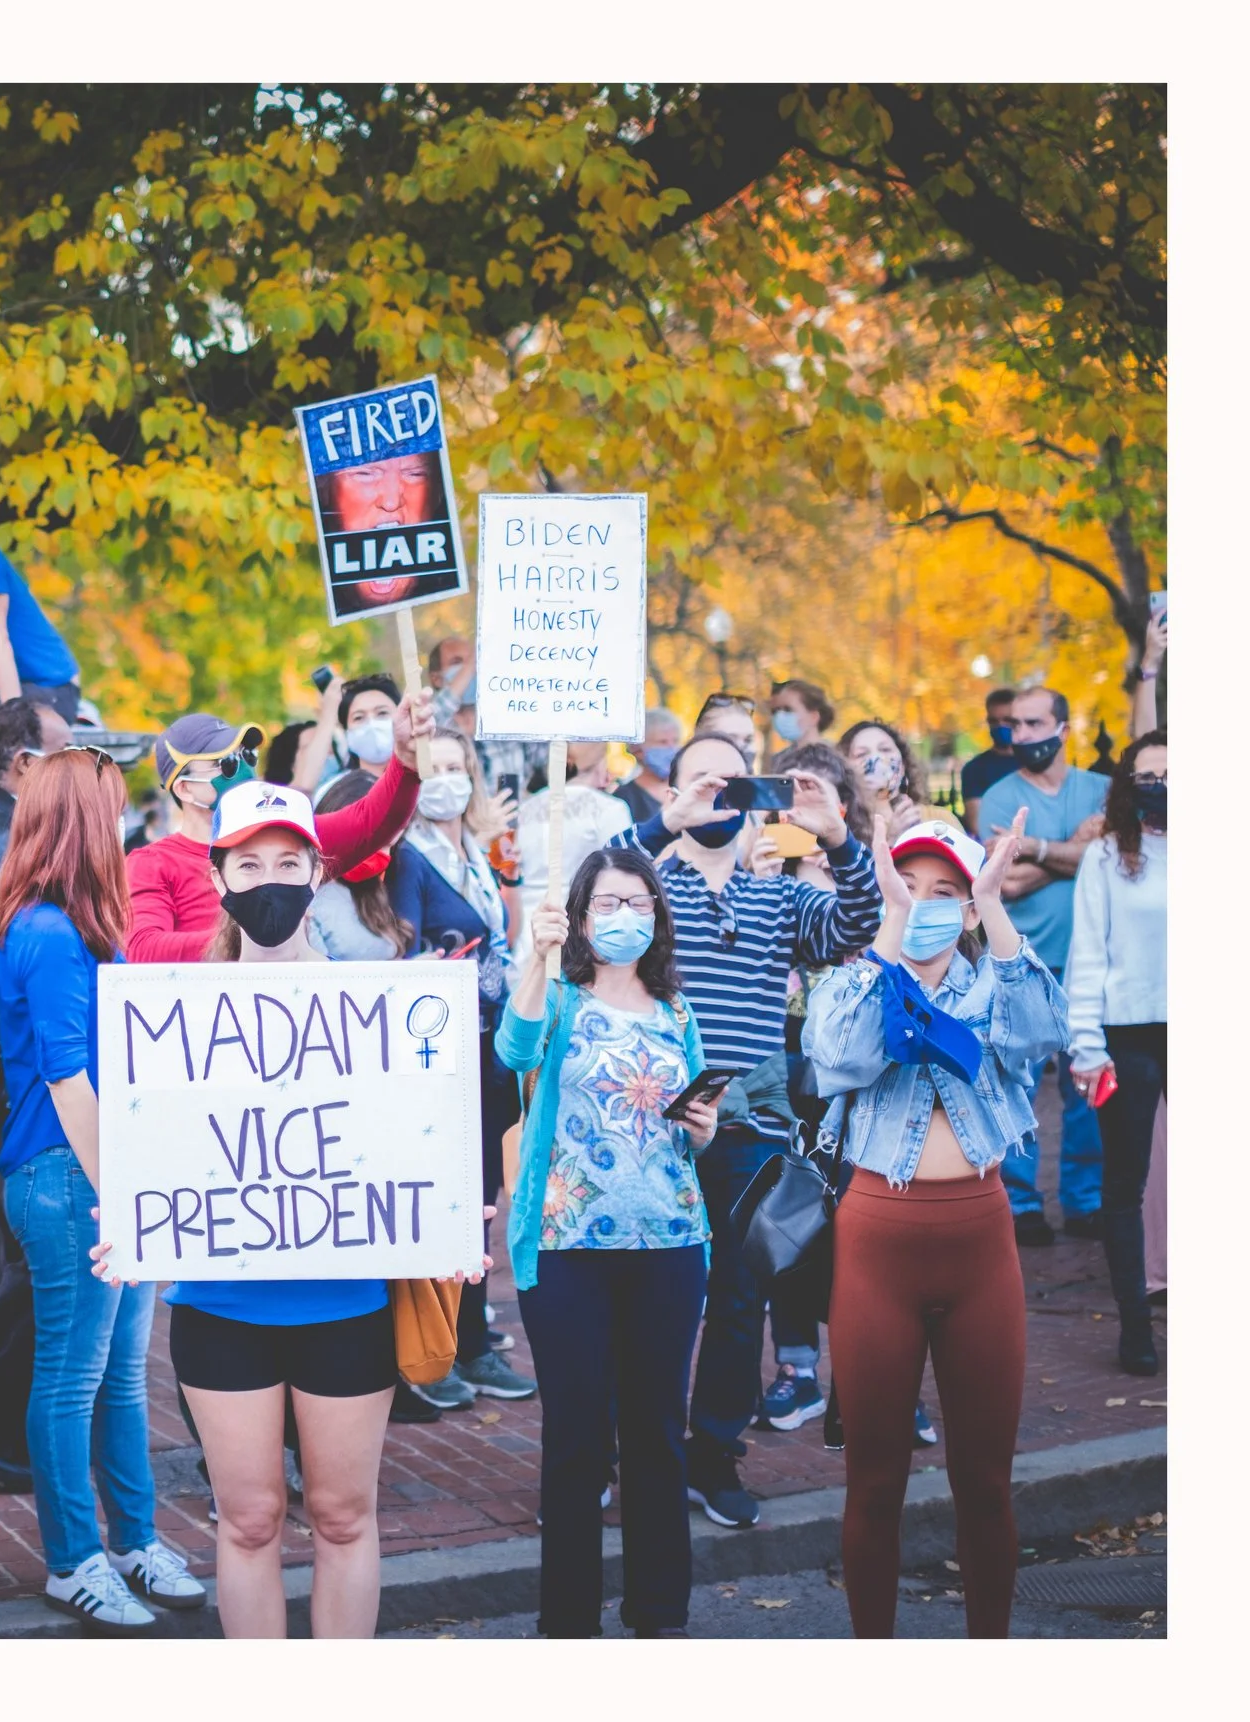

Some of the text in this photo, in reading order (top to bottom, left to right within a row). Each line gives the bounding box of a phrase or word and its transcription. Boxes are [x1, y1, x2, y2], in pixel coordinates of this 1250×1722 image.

[319, 391, 437, 462] FIRED
[333, 531, 448, 574] LIAR
[513, 606, 602, 640] HONESTY
[510, 643, 599, 671] DECENCY
[488, 675, 610, 693] COMPETENCE
[507, 696, 609, 718] ARE BACK!
[124, 990, 390, 1085] MADAM
[208, 1100, 352, 1182] VICE
[135, 1180, 435, 1262] PRESIDENT
